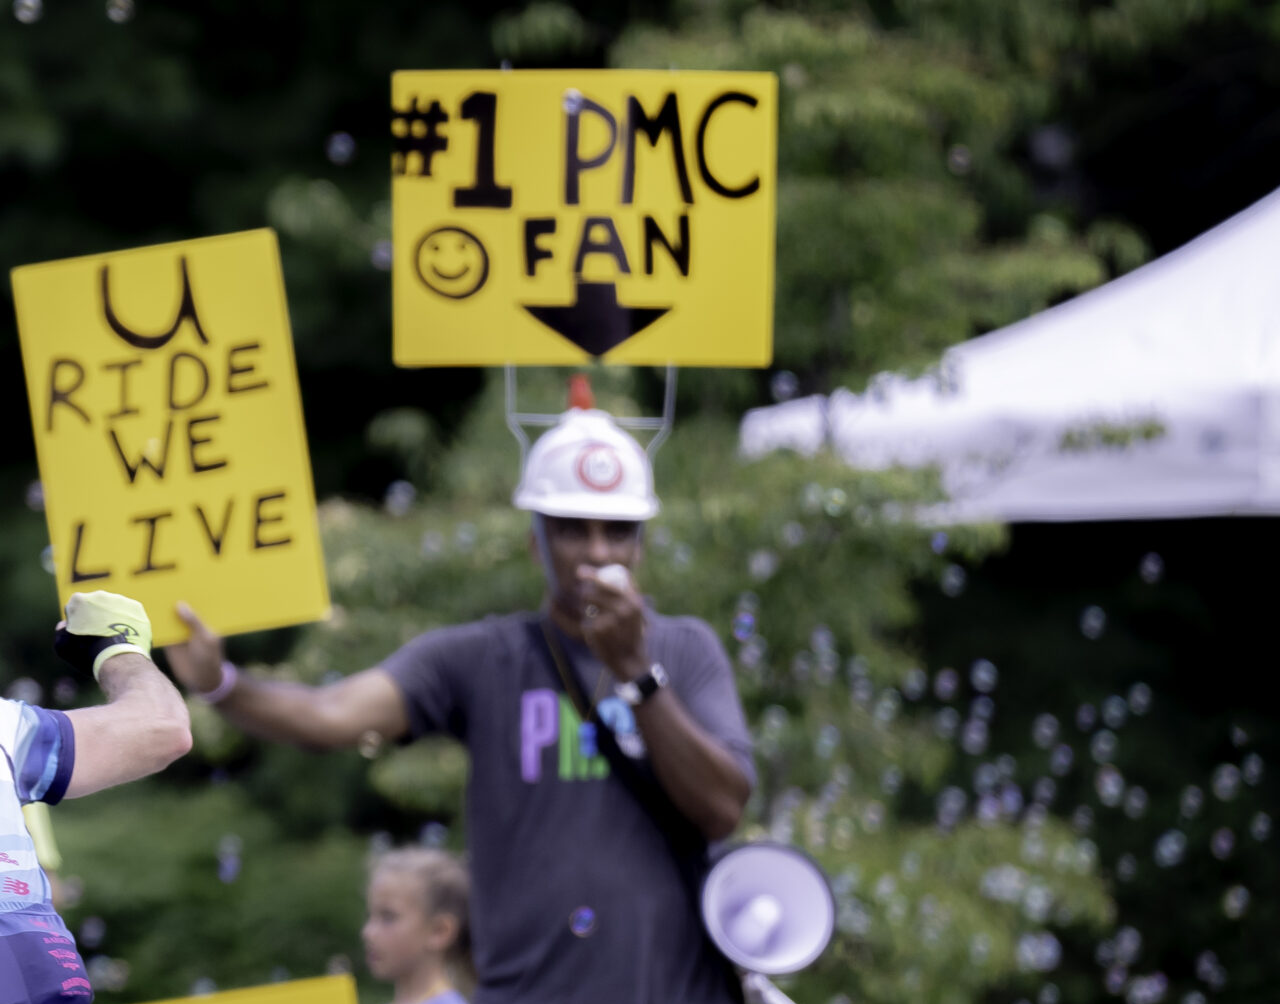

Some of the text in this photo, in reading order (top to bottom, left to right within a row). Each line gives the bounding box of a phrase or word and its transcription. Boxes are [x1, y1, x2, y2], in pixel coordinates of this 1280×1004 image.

[392, 90, 761, 209] #1 PMC
[523, 213, 691, 278] FAN
[100, 254, 210, 350] U
[45, 341, 270, 433] RIDE
[109, 413, 228, 485] WE
[70, 492, 293, 584] LIVE
